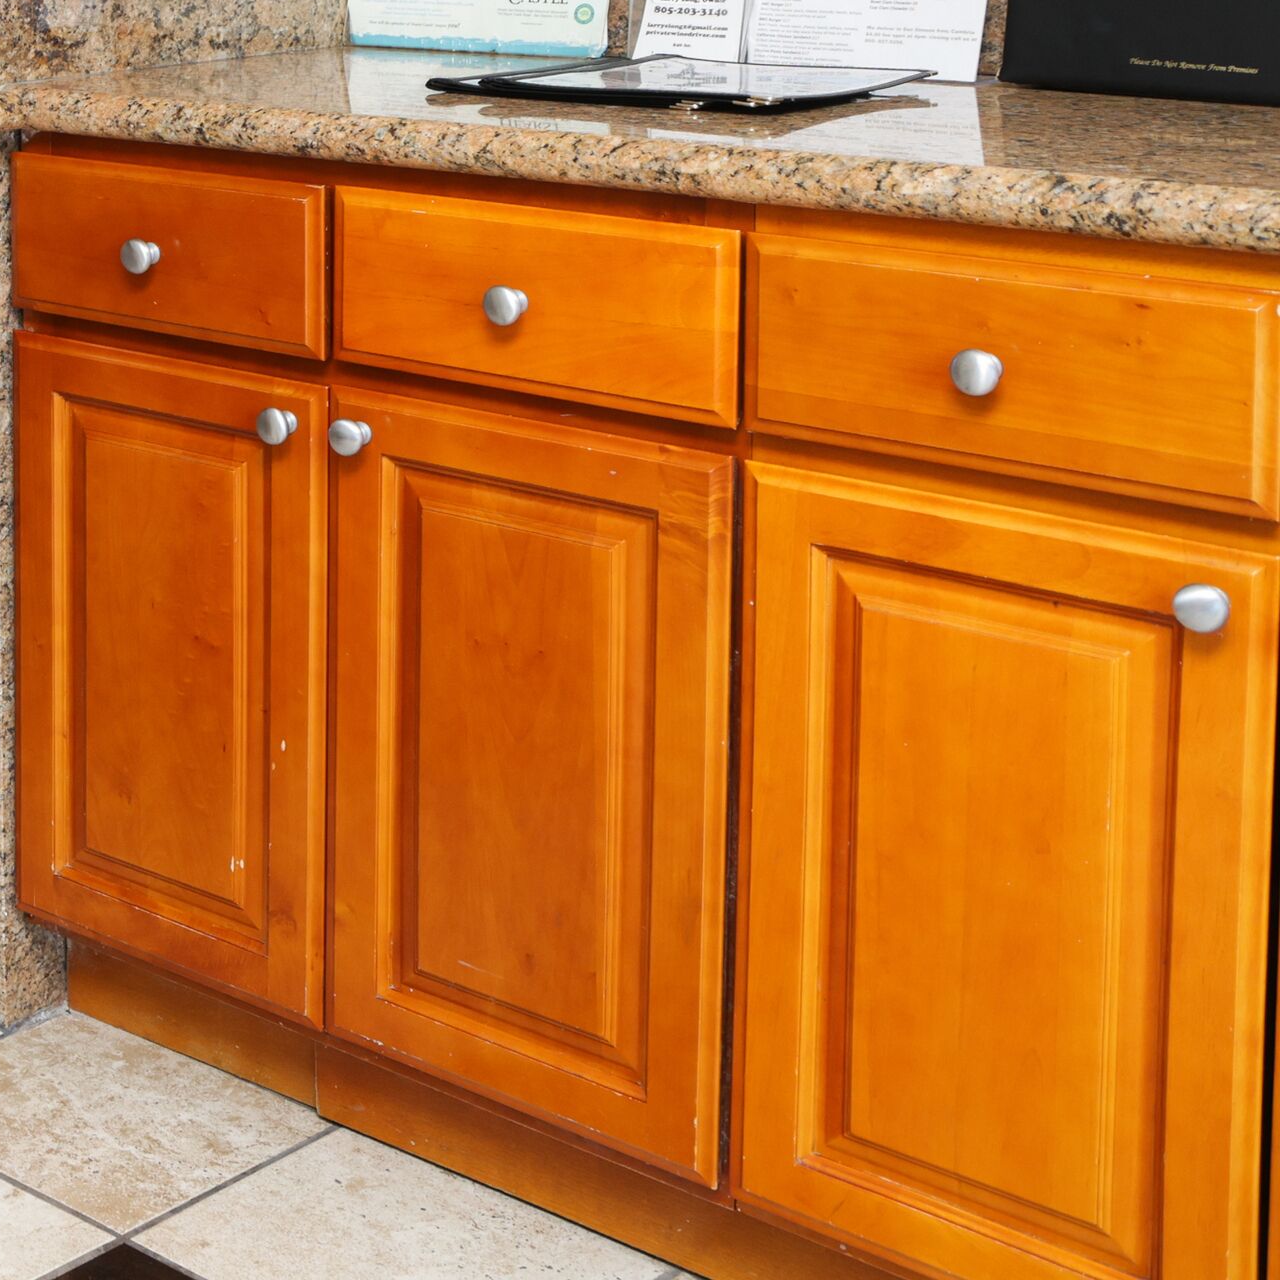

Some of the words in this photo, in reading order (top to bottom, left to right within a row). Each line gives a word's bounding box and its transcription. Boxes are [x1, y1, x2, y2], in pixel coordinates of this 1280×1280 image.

[654, 5, 728, 17] 805-203-3140
[1129, 57, 1150, 67] Please
[1163, 60, 1178, 69] Not
[1179, 61, 1207, 70] Remove
[1207, 63, 1227, 71] From
[1227, 65, 1259, 74] Premises
